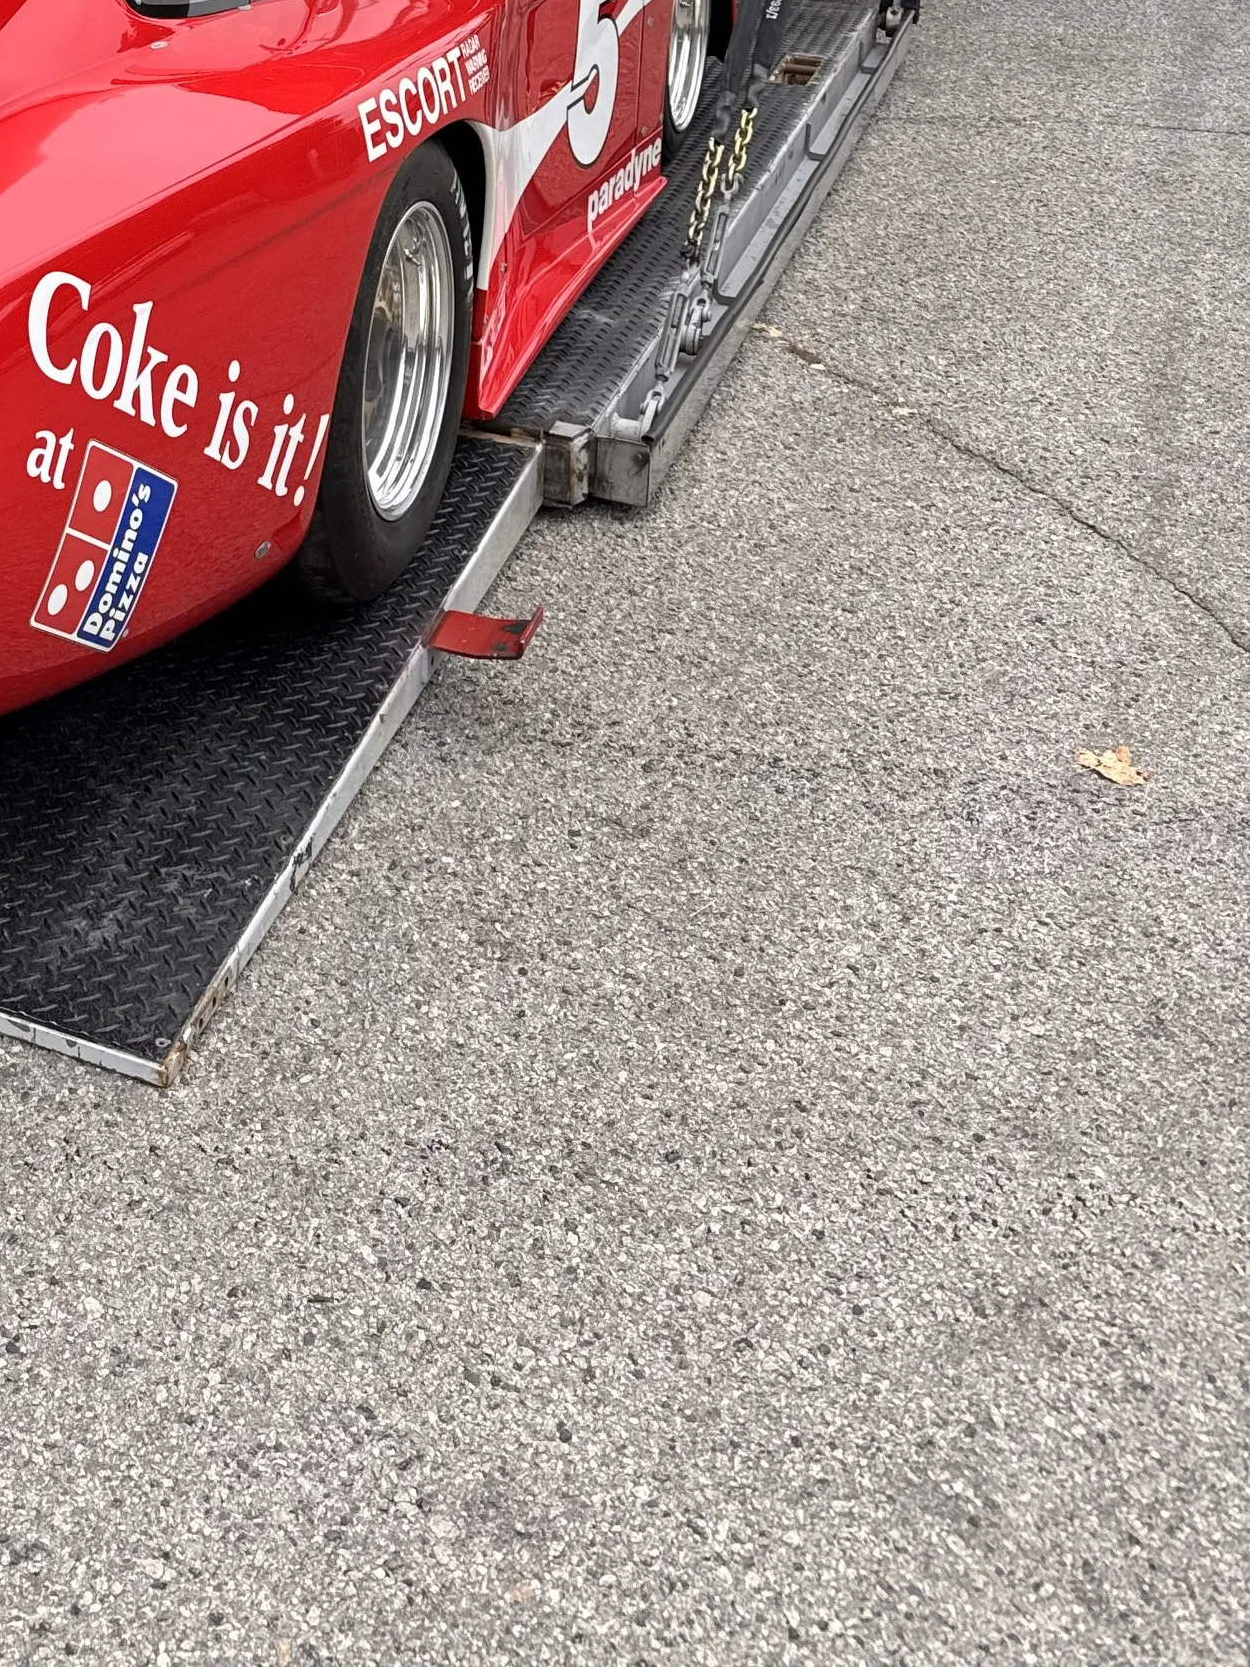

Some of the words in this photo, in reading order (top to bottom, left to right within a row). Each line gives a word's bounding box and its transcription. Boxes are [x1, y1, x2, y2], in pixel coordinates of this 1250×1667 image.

[460, 34, 481, 59] RADAR
[357, 46, 466, 163] ESCORT
[587, 137, 662, 233] paradyne
[28, 271, 199, 438] Coke
[203, 359, 259, 470] is
[257, 393, 330, 507] it!
[26, 427, 75, 490] at
[82, 484, 151, 635] Domino's
[99, 551, 149, 641] Pizza
